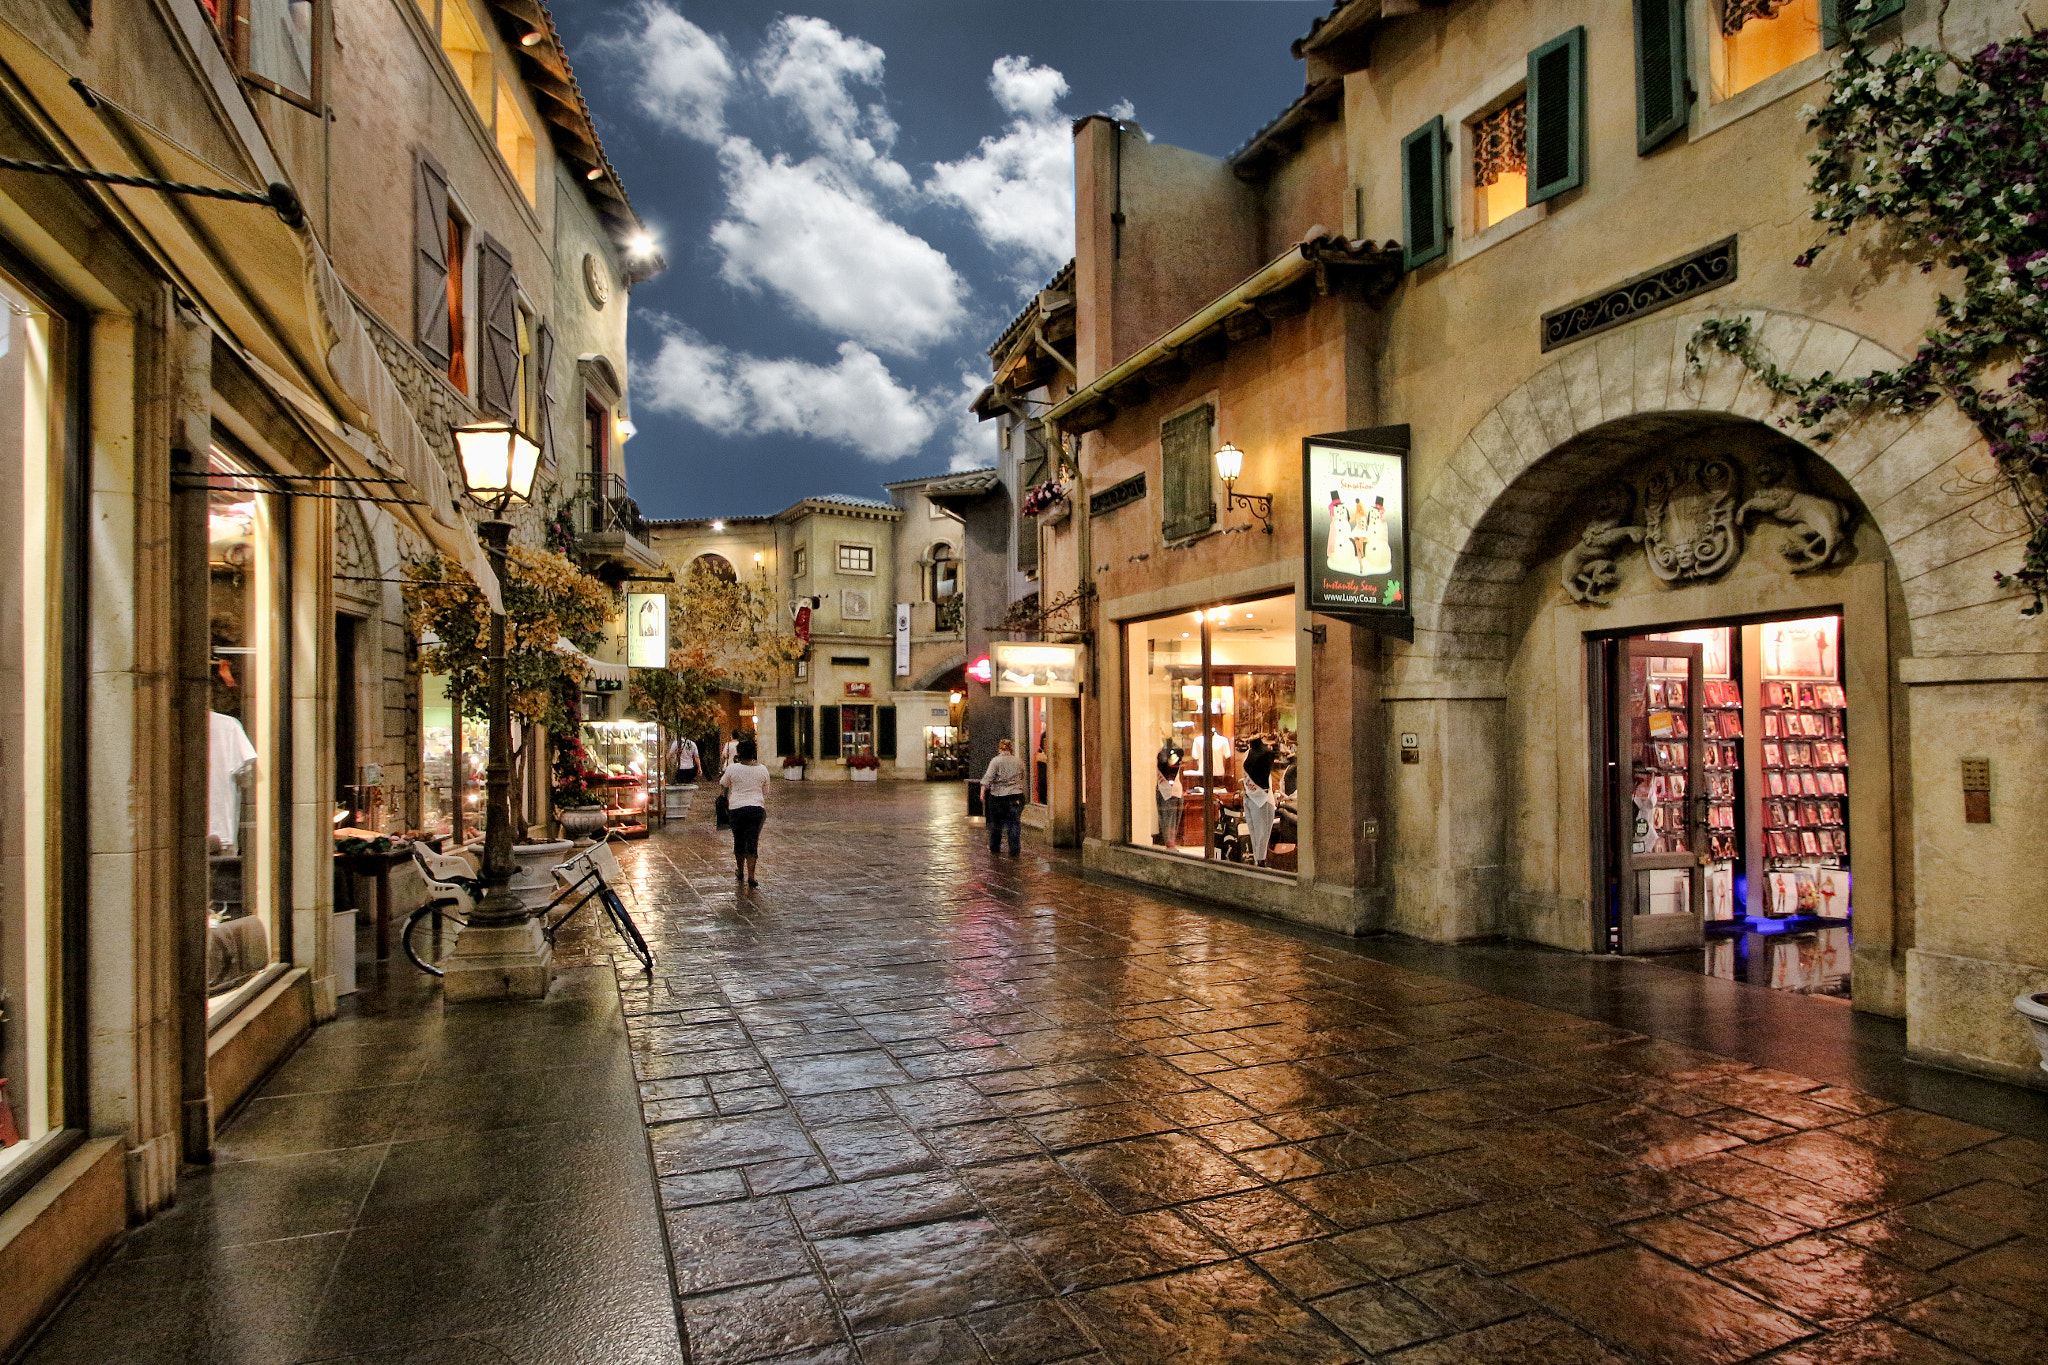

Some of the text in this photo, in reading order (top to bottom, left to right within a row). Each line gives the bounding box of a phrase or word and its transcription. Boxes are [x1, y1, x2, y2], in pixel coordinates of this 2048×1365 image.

[1329, 452, 1385, 486] Luxy
[1340, 478, 1374, 490] Sensation
[1323, 578, 1378, 595] Instantly Sexy
